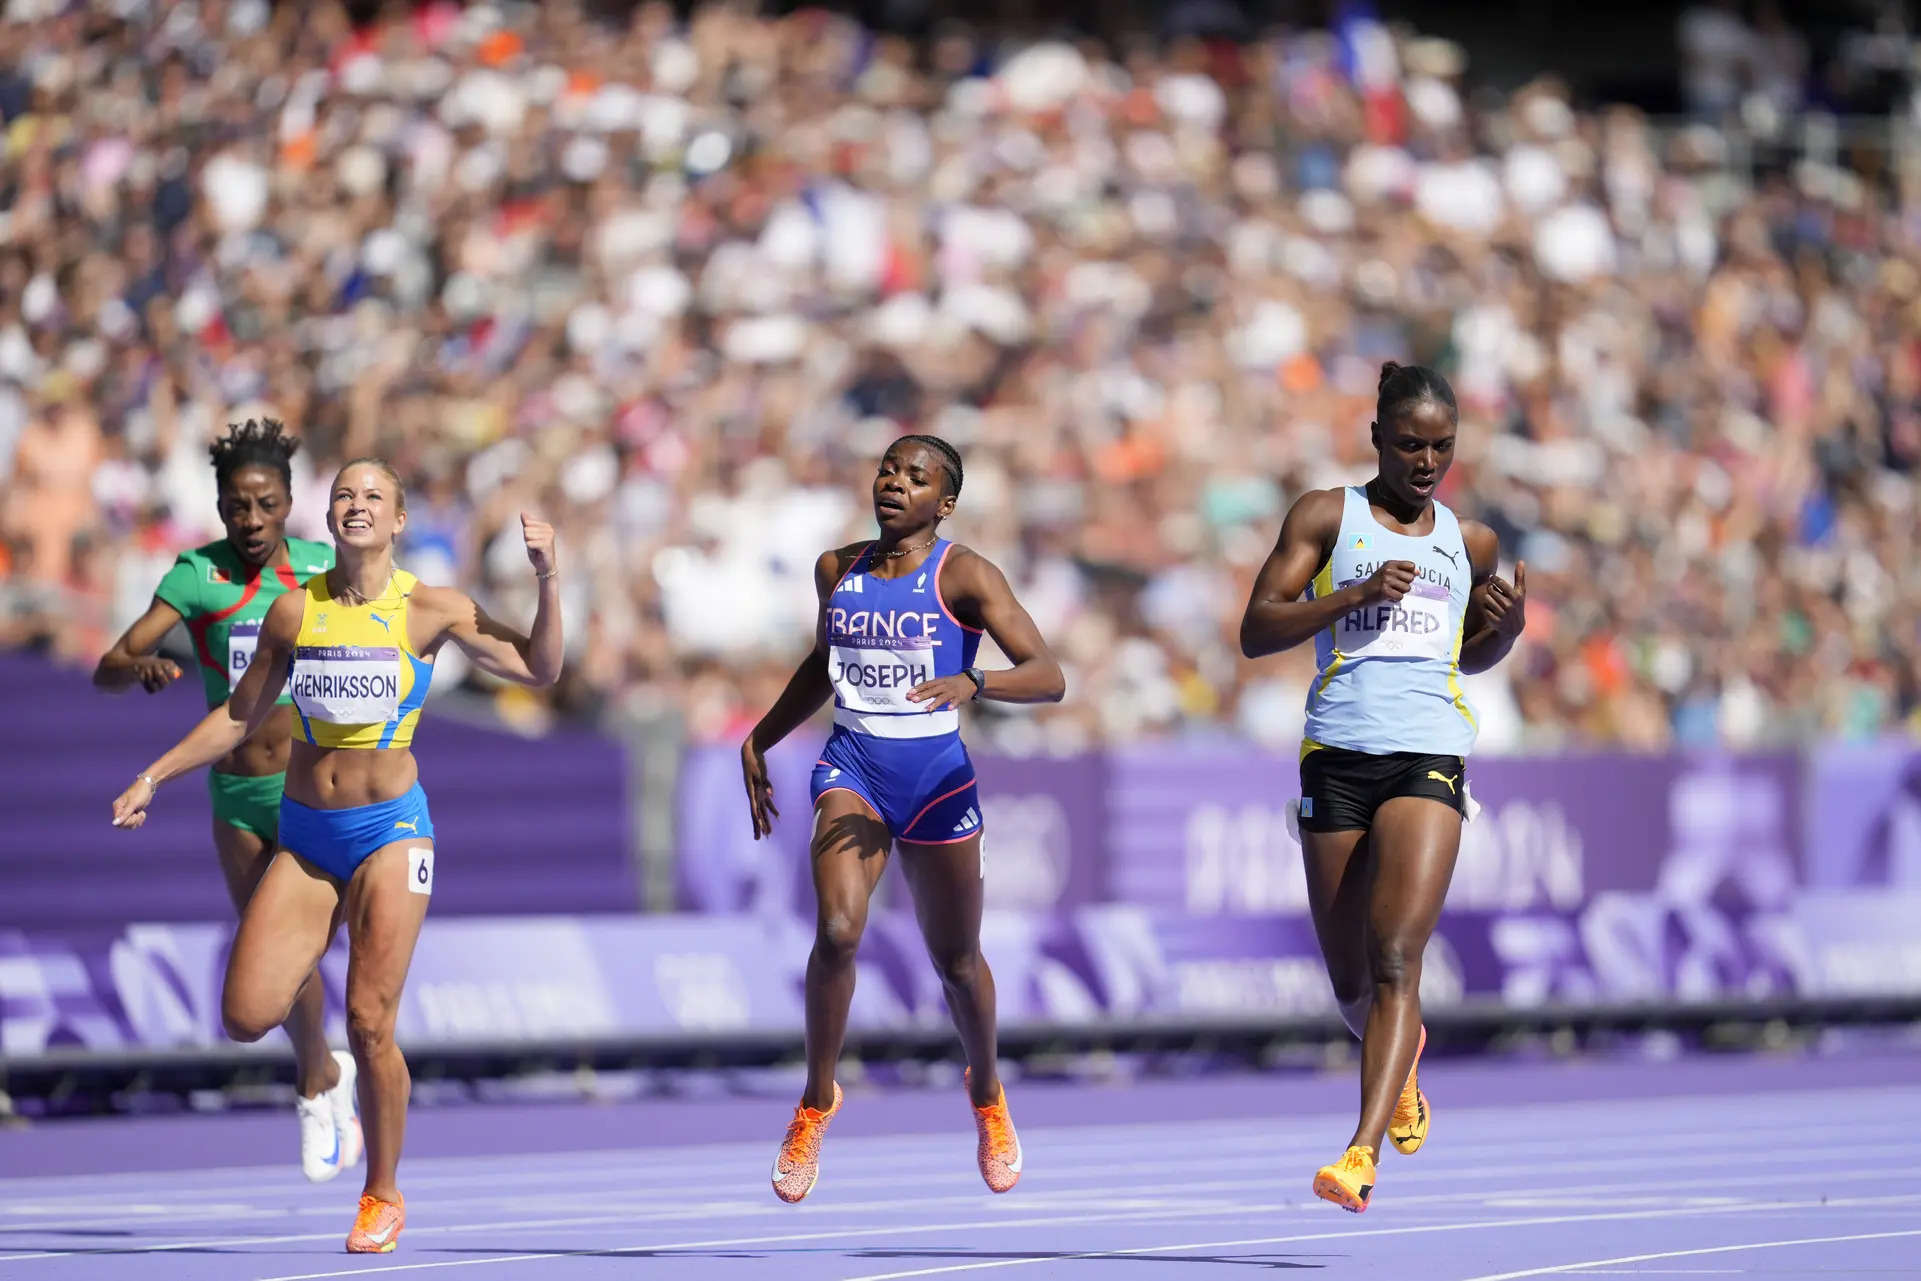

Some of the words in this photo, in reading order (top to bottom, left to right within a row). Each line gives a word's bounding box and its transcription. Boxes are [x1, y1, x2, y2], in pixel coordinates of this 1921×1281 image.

[1344, 606, 1440, 635] ALFRED
[318, 649, 342, 657] PARIS
[344, 649, 371, 658] 2024
[852, 637, 876, 646] PARIS
[879, 637, 903, 647] 2024
[293, 673, 397, 698] HENRIKSSON
[834, 661, 927, 688] JOSEPH
[417, 857, 428, 885] 6
